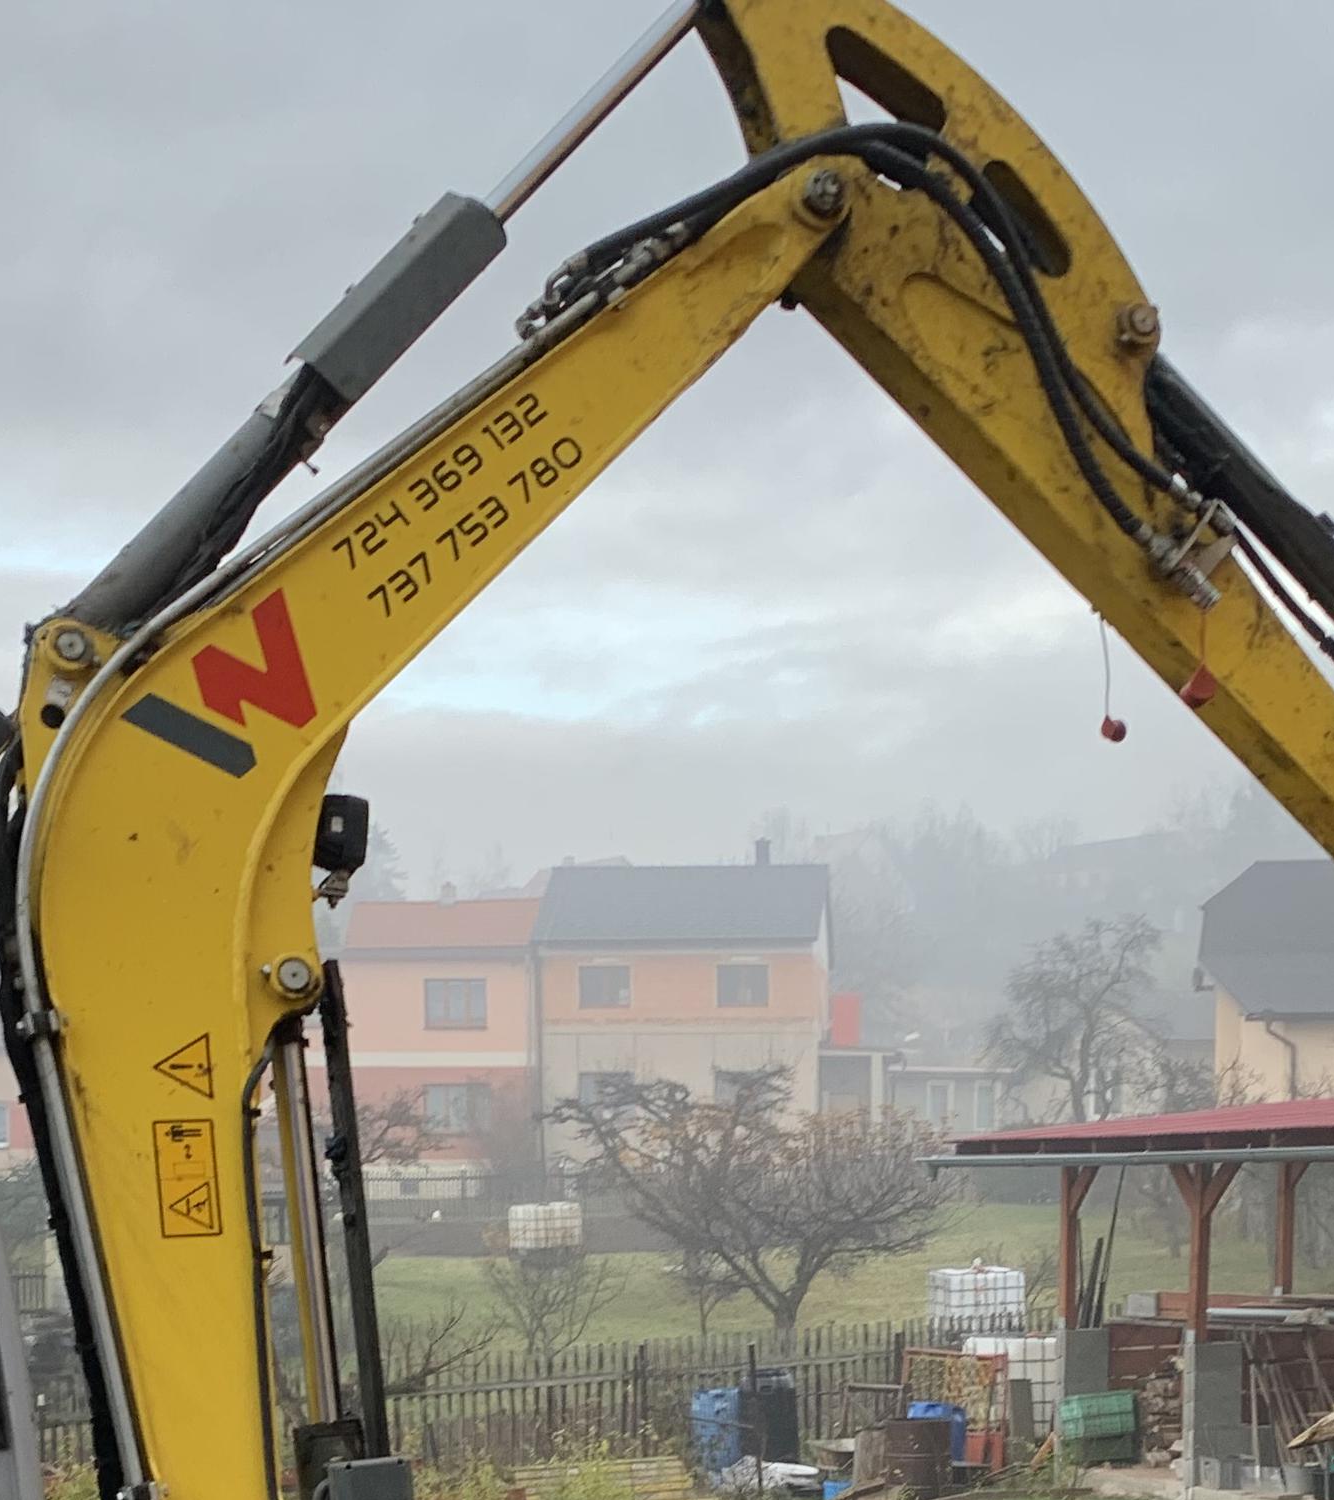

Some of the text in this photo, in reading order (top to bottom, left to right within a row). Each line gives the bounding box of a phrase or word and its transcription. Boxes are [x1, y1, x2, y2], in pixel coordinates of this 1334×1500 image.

[332, 392, 549, 571] 724 369 132
[367, 436, 583, 619] 737 753 780
